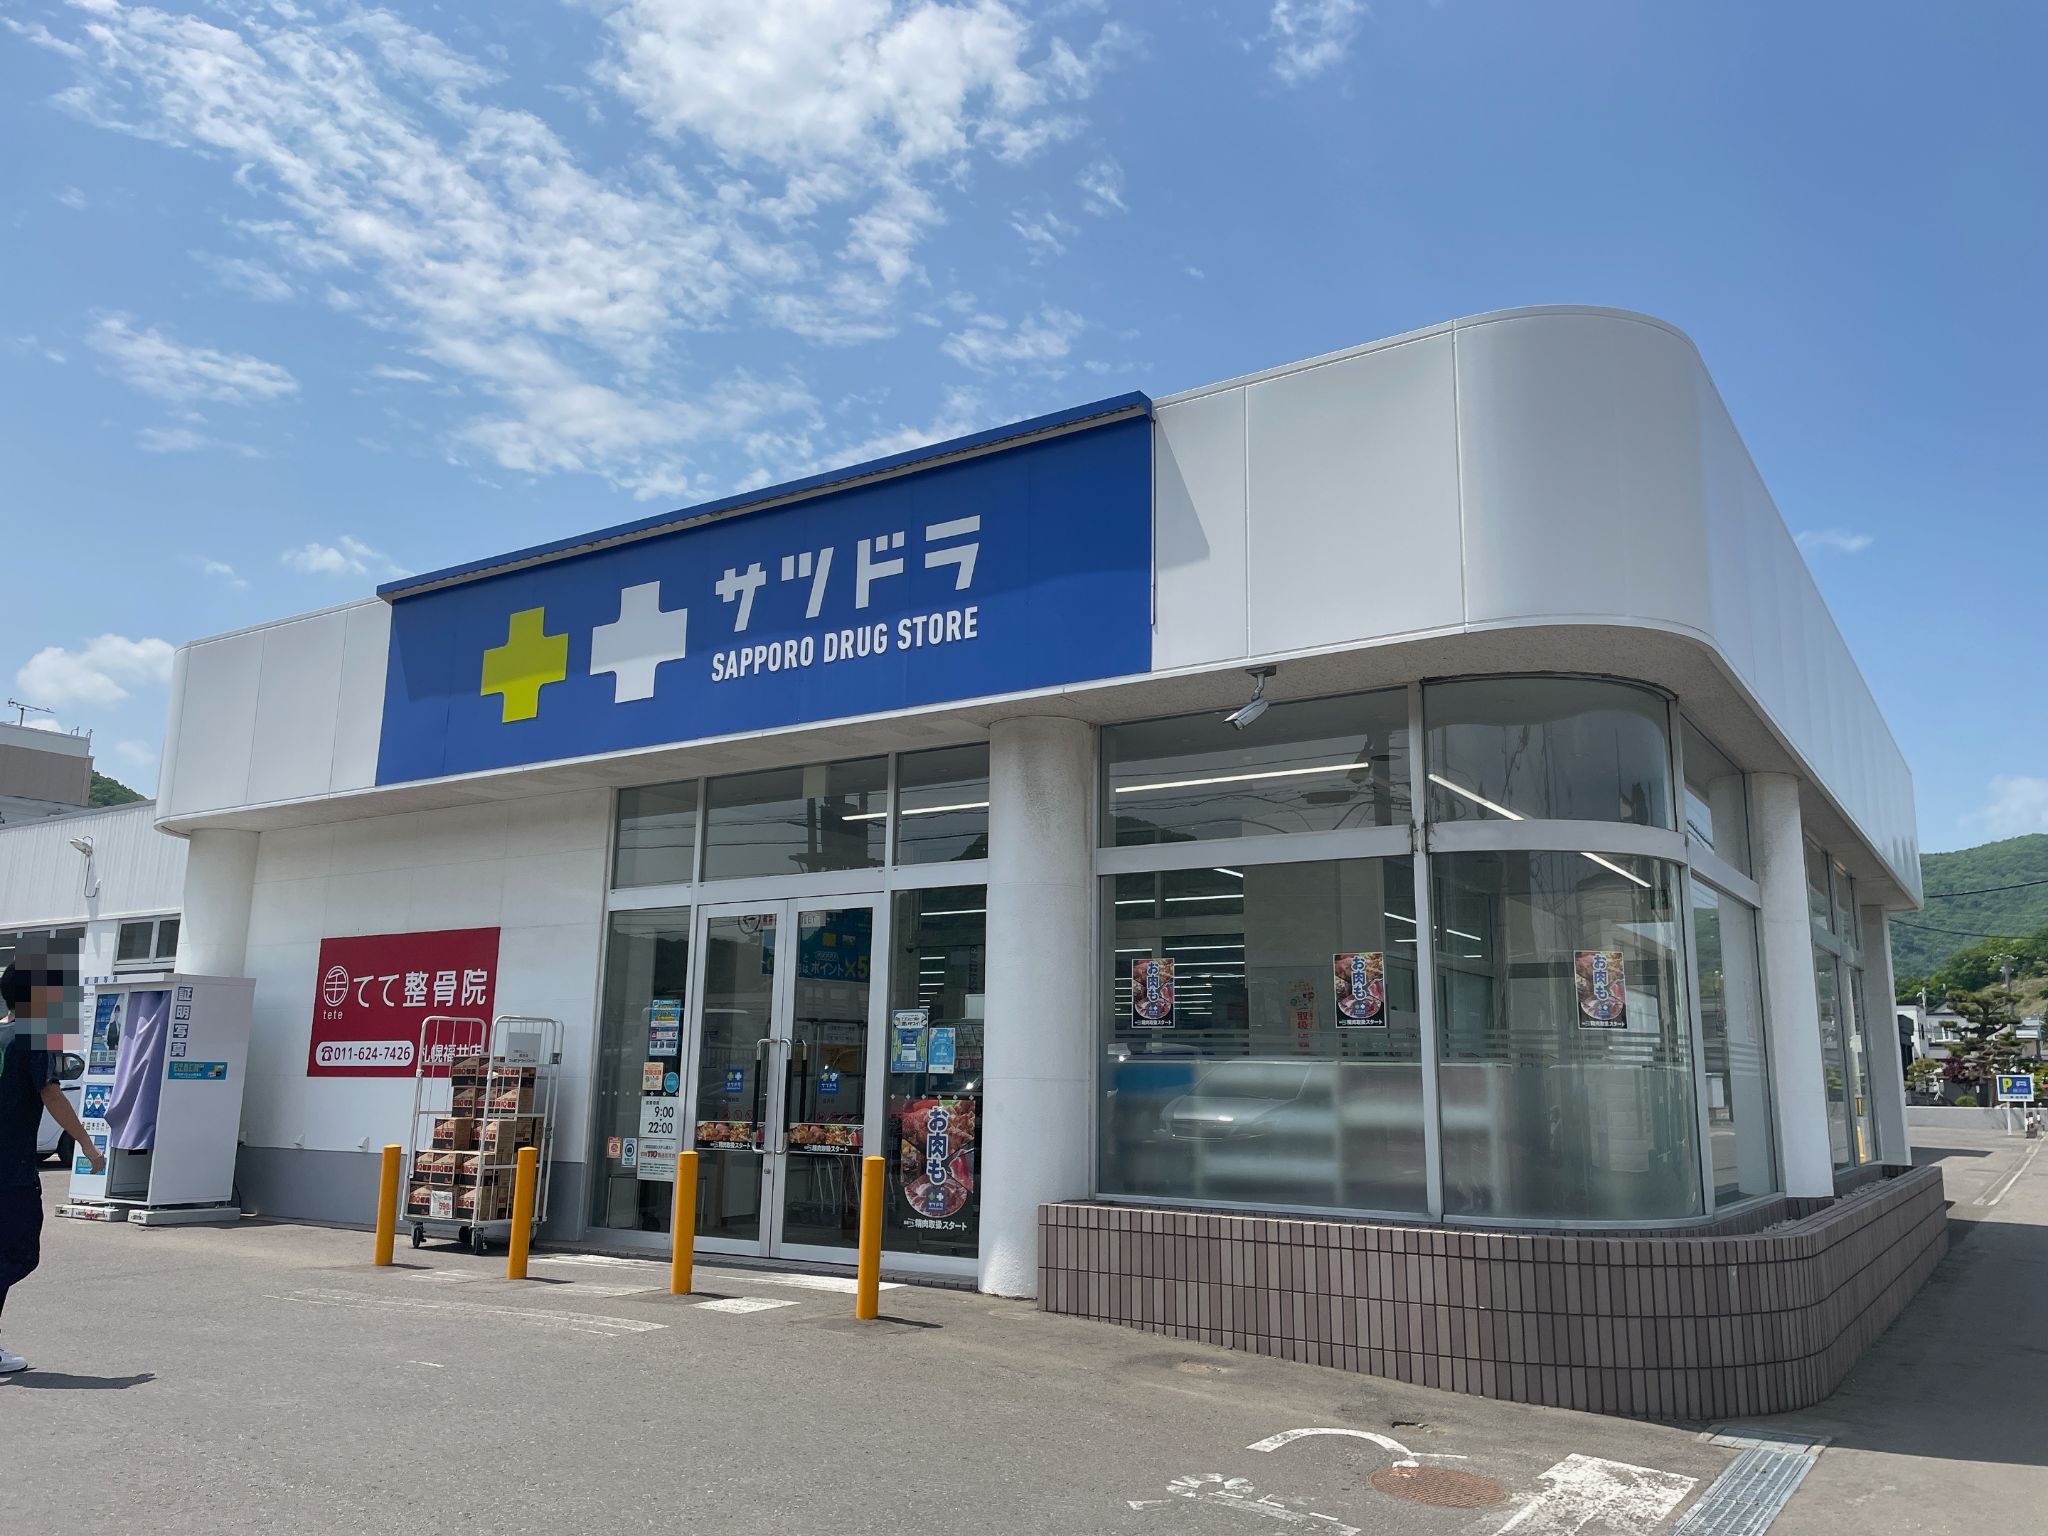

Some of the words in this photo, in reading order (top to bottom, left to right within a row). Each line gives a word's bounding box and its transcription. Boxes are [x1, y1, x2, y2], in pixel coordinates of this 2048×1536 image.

[715, 515, 981, 632] サツドラ
[711, 635, 814, 682] SAPPORO
[823, 623, 888, 664] DRUG
[897, 606, 979, 650] STORE
[353, 968, 488, 1008] てて整骨院
[1146, 961, 1160, 1002] お肉も
[1351, 955, 1367, 1000] お肉も
[1592, 953, 1608, 1000] お肉も
[170, 987, 193, 1057] 証明写真
[323, 1009, 343, 1020] tete
[334, 1046, 411, 1061] 011-624-7426
[648, 1121, 673, 1134] 22:00
[654, 1106, 675, 1118] 9:00
[927, 1105, 949, 1185] お肉も
